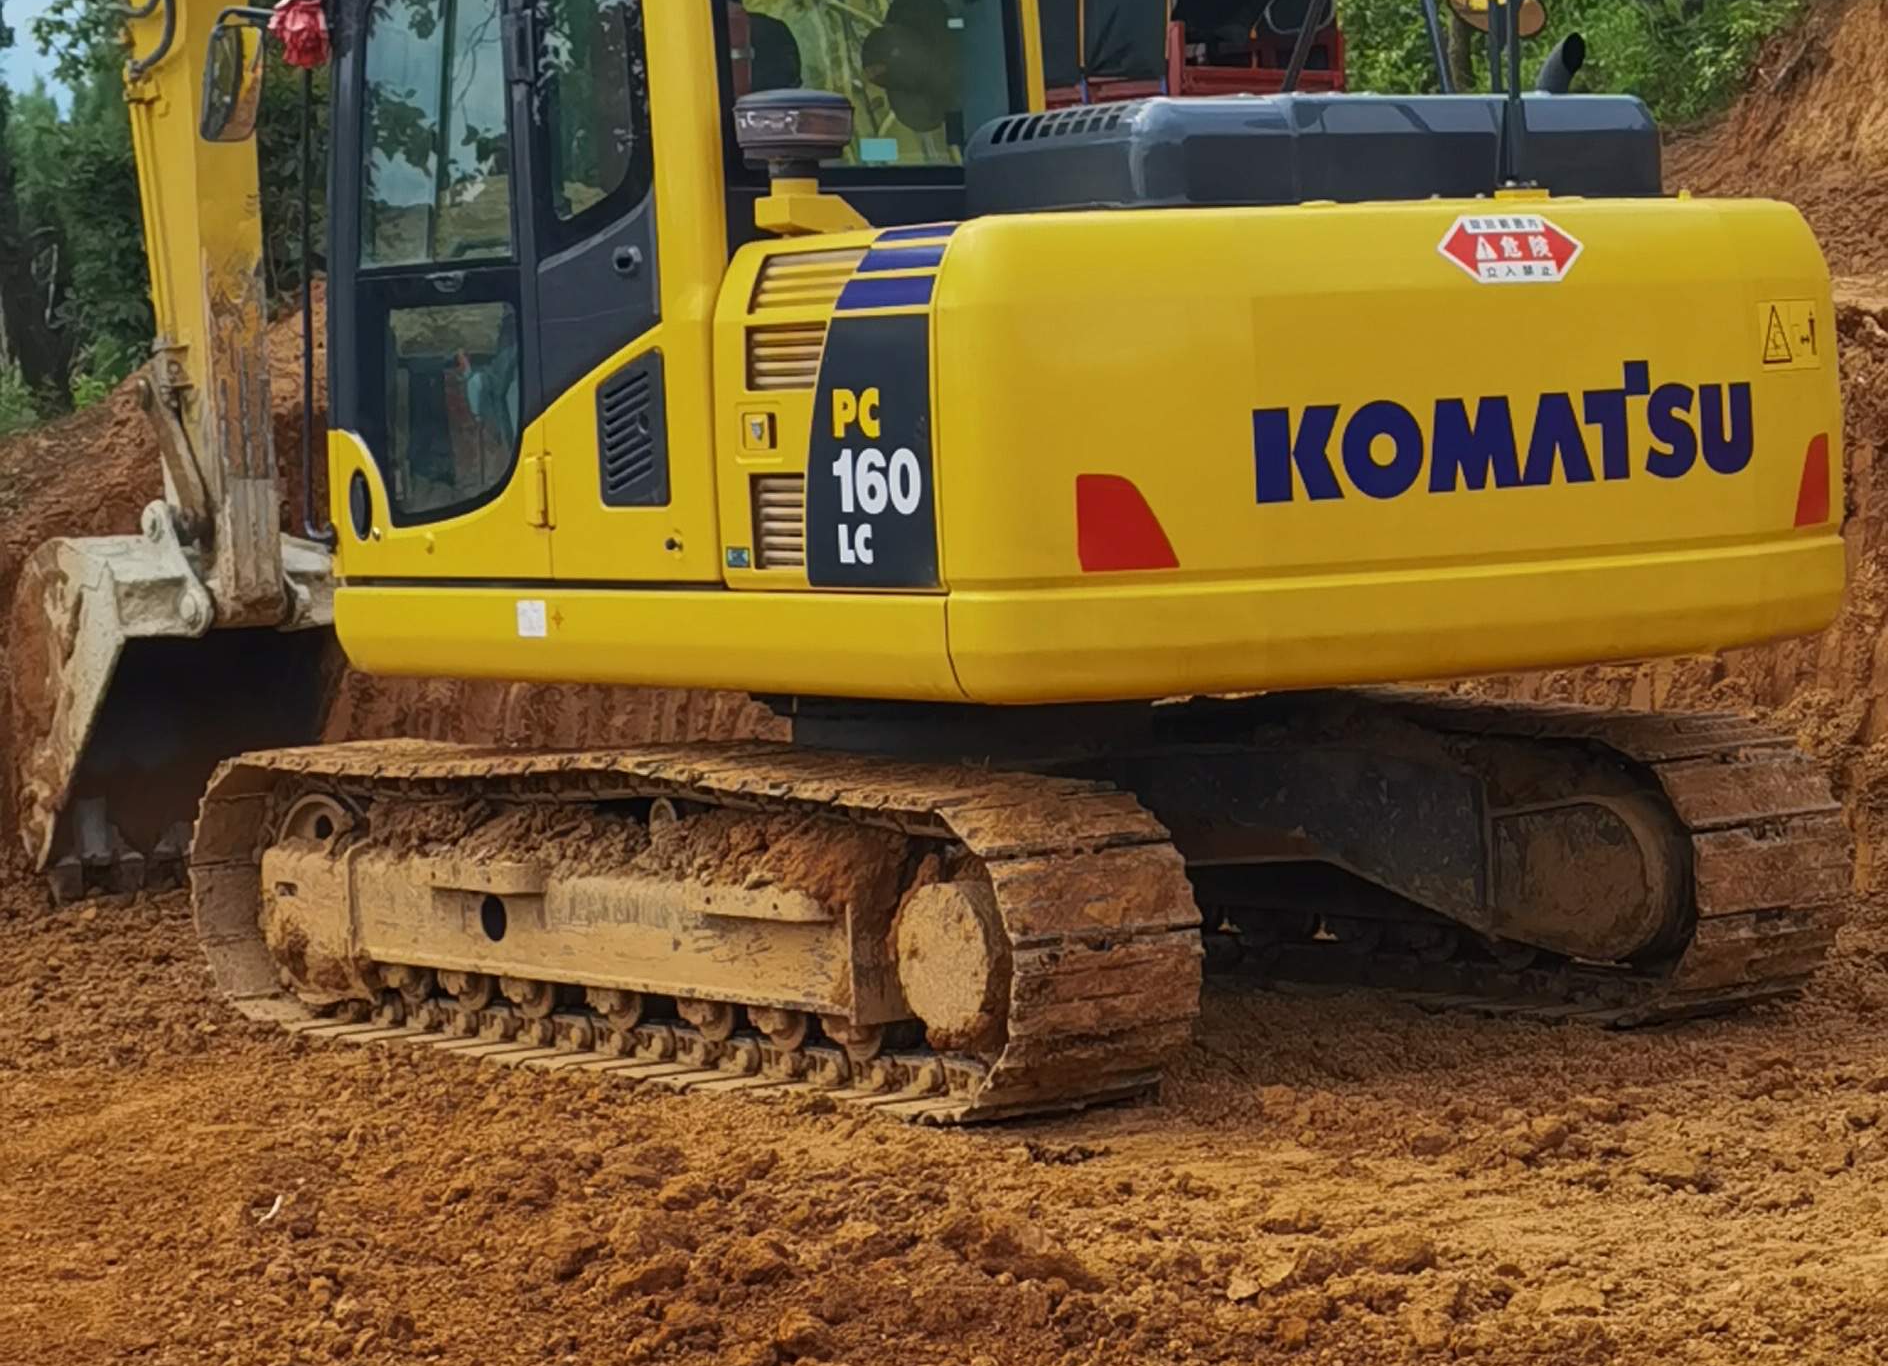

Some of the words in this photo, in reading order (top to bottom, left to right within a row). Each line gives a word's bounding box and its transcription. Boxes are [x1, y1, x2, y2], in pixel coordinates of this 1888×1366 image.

[832, 387, 881, 439] PC
[1252, 360, 1753, 504] KOMATSU
[832, 447, 922, 515] 160
[838, 523, 874, 564] LC
